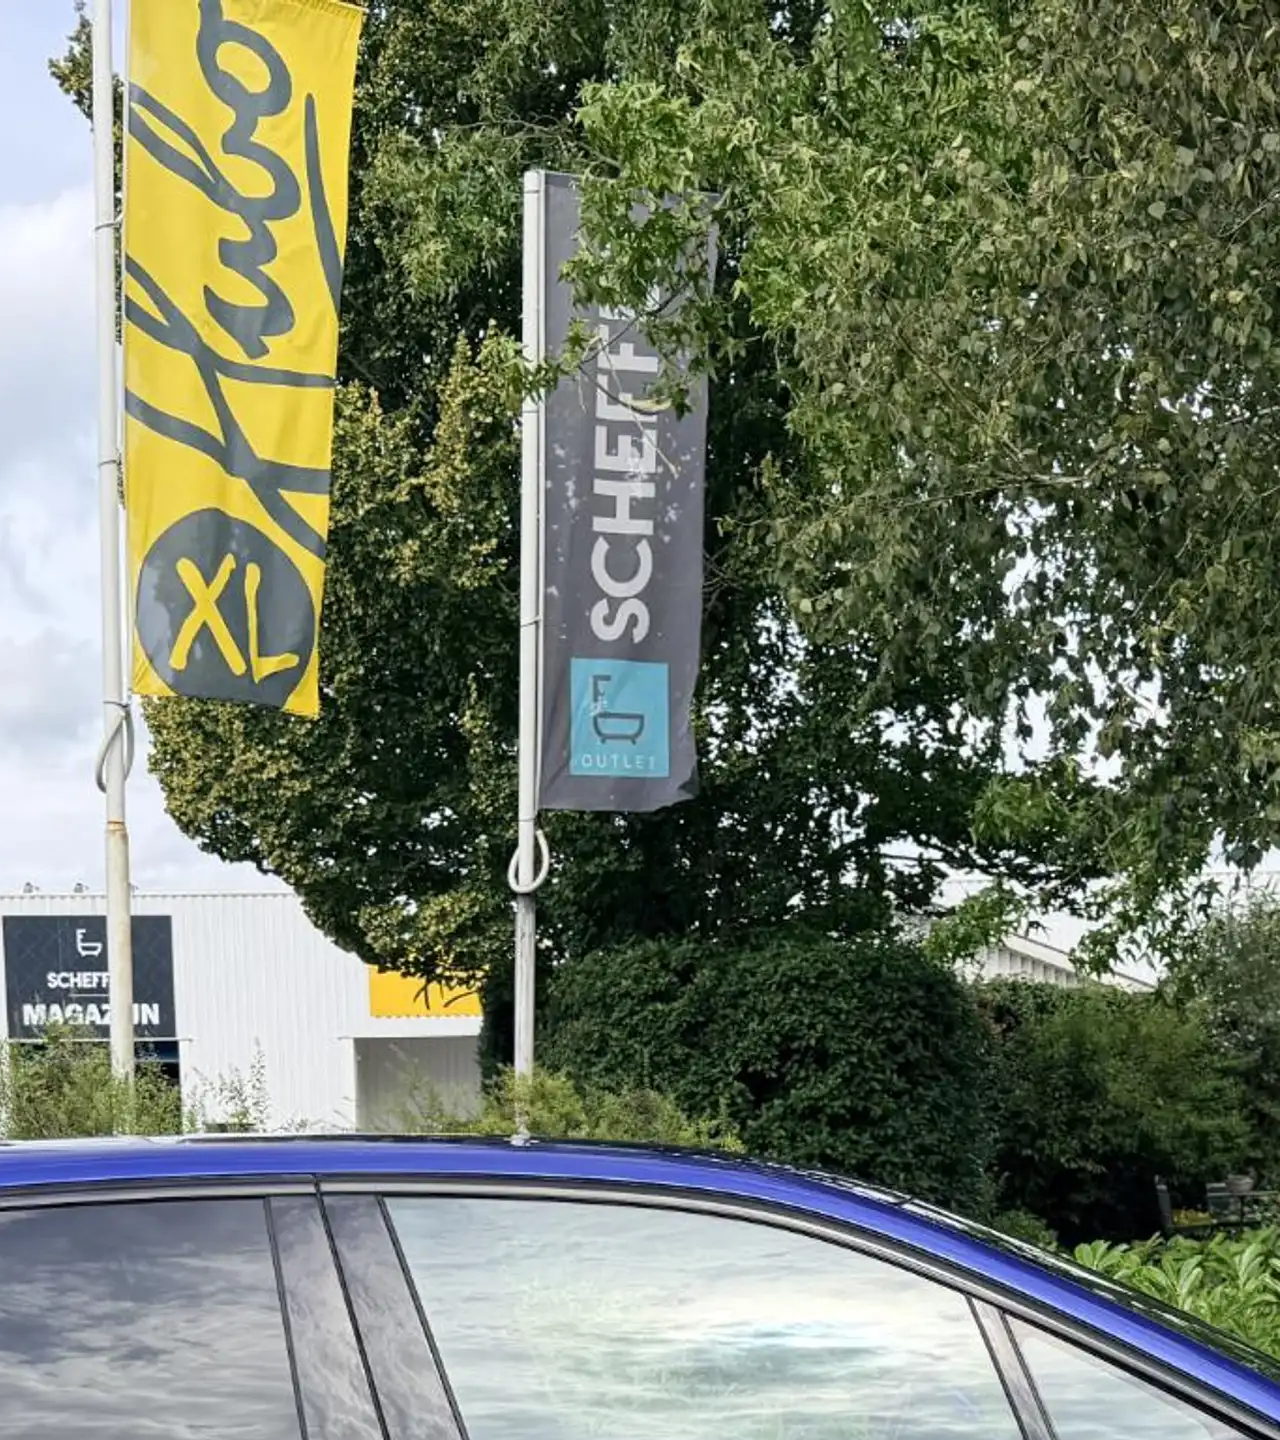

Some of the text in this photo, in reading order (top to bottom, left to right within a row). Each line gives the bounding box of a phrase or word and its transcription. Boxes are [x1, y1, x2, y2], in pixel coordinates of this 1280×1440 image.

[170, 552, 299, 684] XL
[581, 753, 656, 770] OUTLET
[46, 971, 110, 989] SCHEFF
